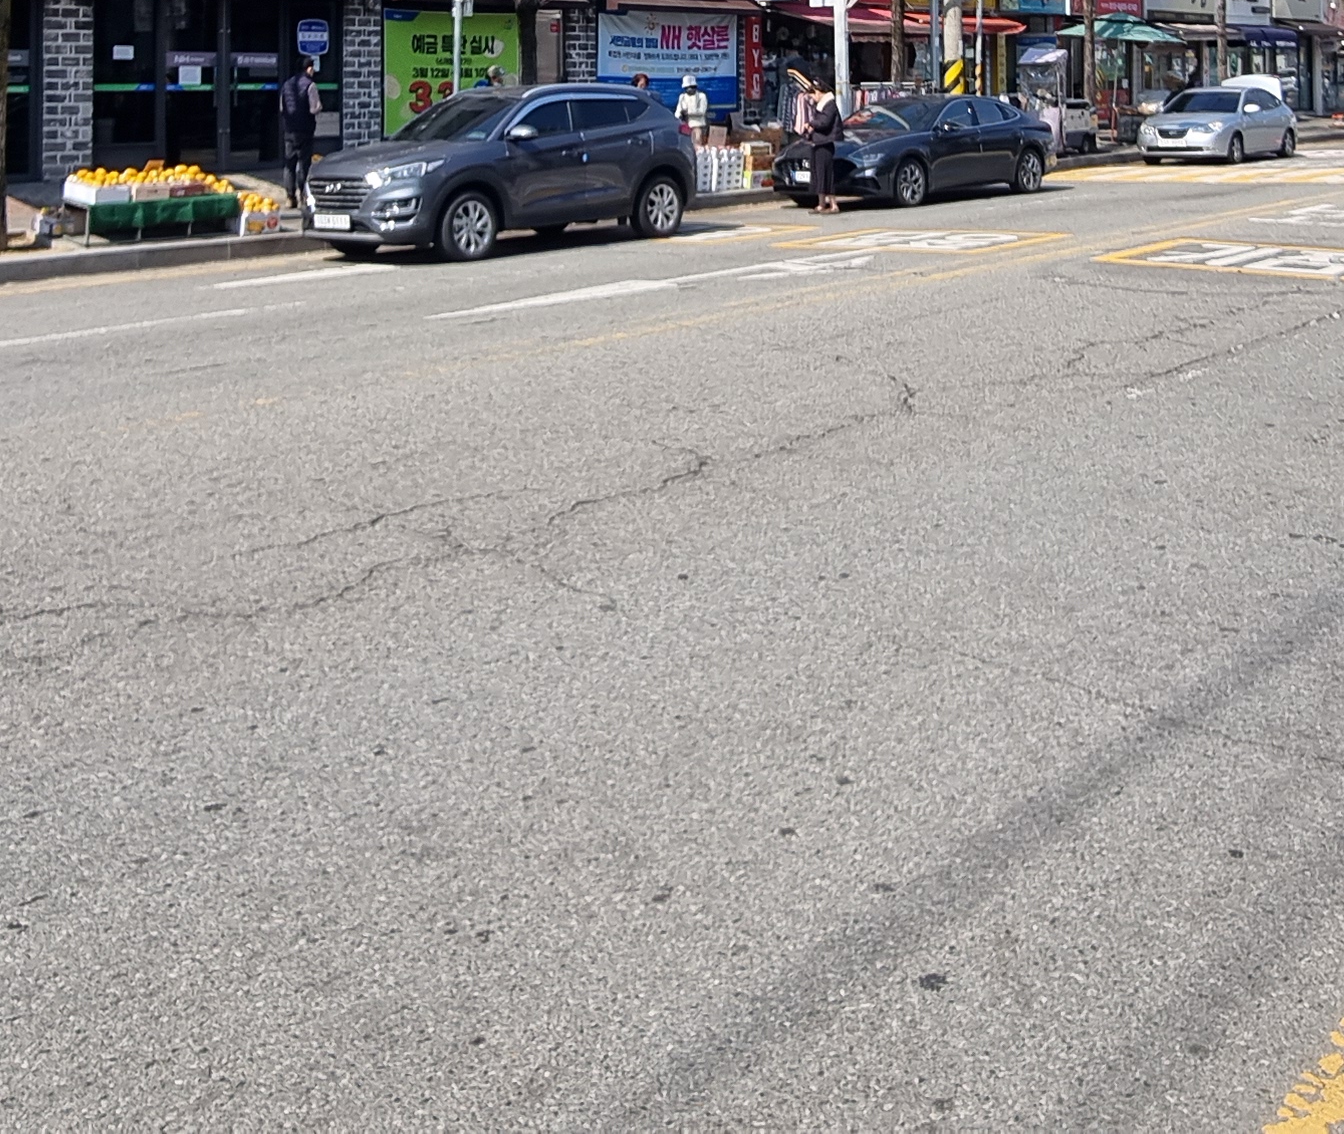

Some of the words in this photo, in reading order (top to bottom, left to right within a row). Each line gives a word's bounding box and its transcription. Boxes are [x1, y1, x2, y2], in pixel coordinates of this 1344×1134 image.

[411, 34, 438, 55] 예금
[470, 35, 495, 55] 실시
[660, 24, 682, 50] NH
[686, 24, 731, 51] 햇살론
